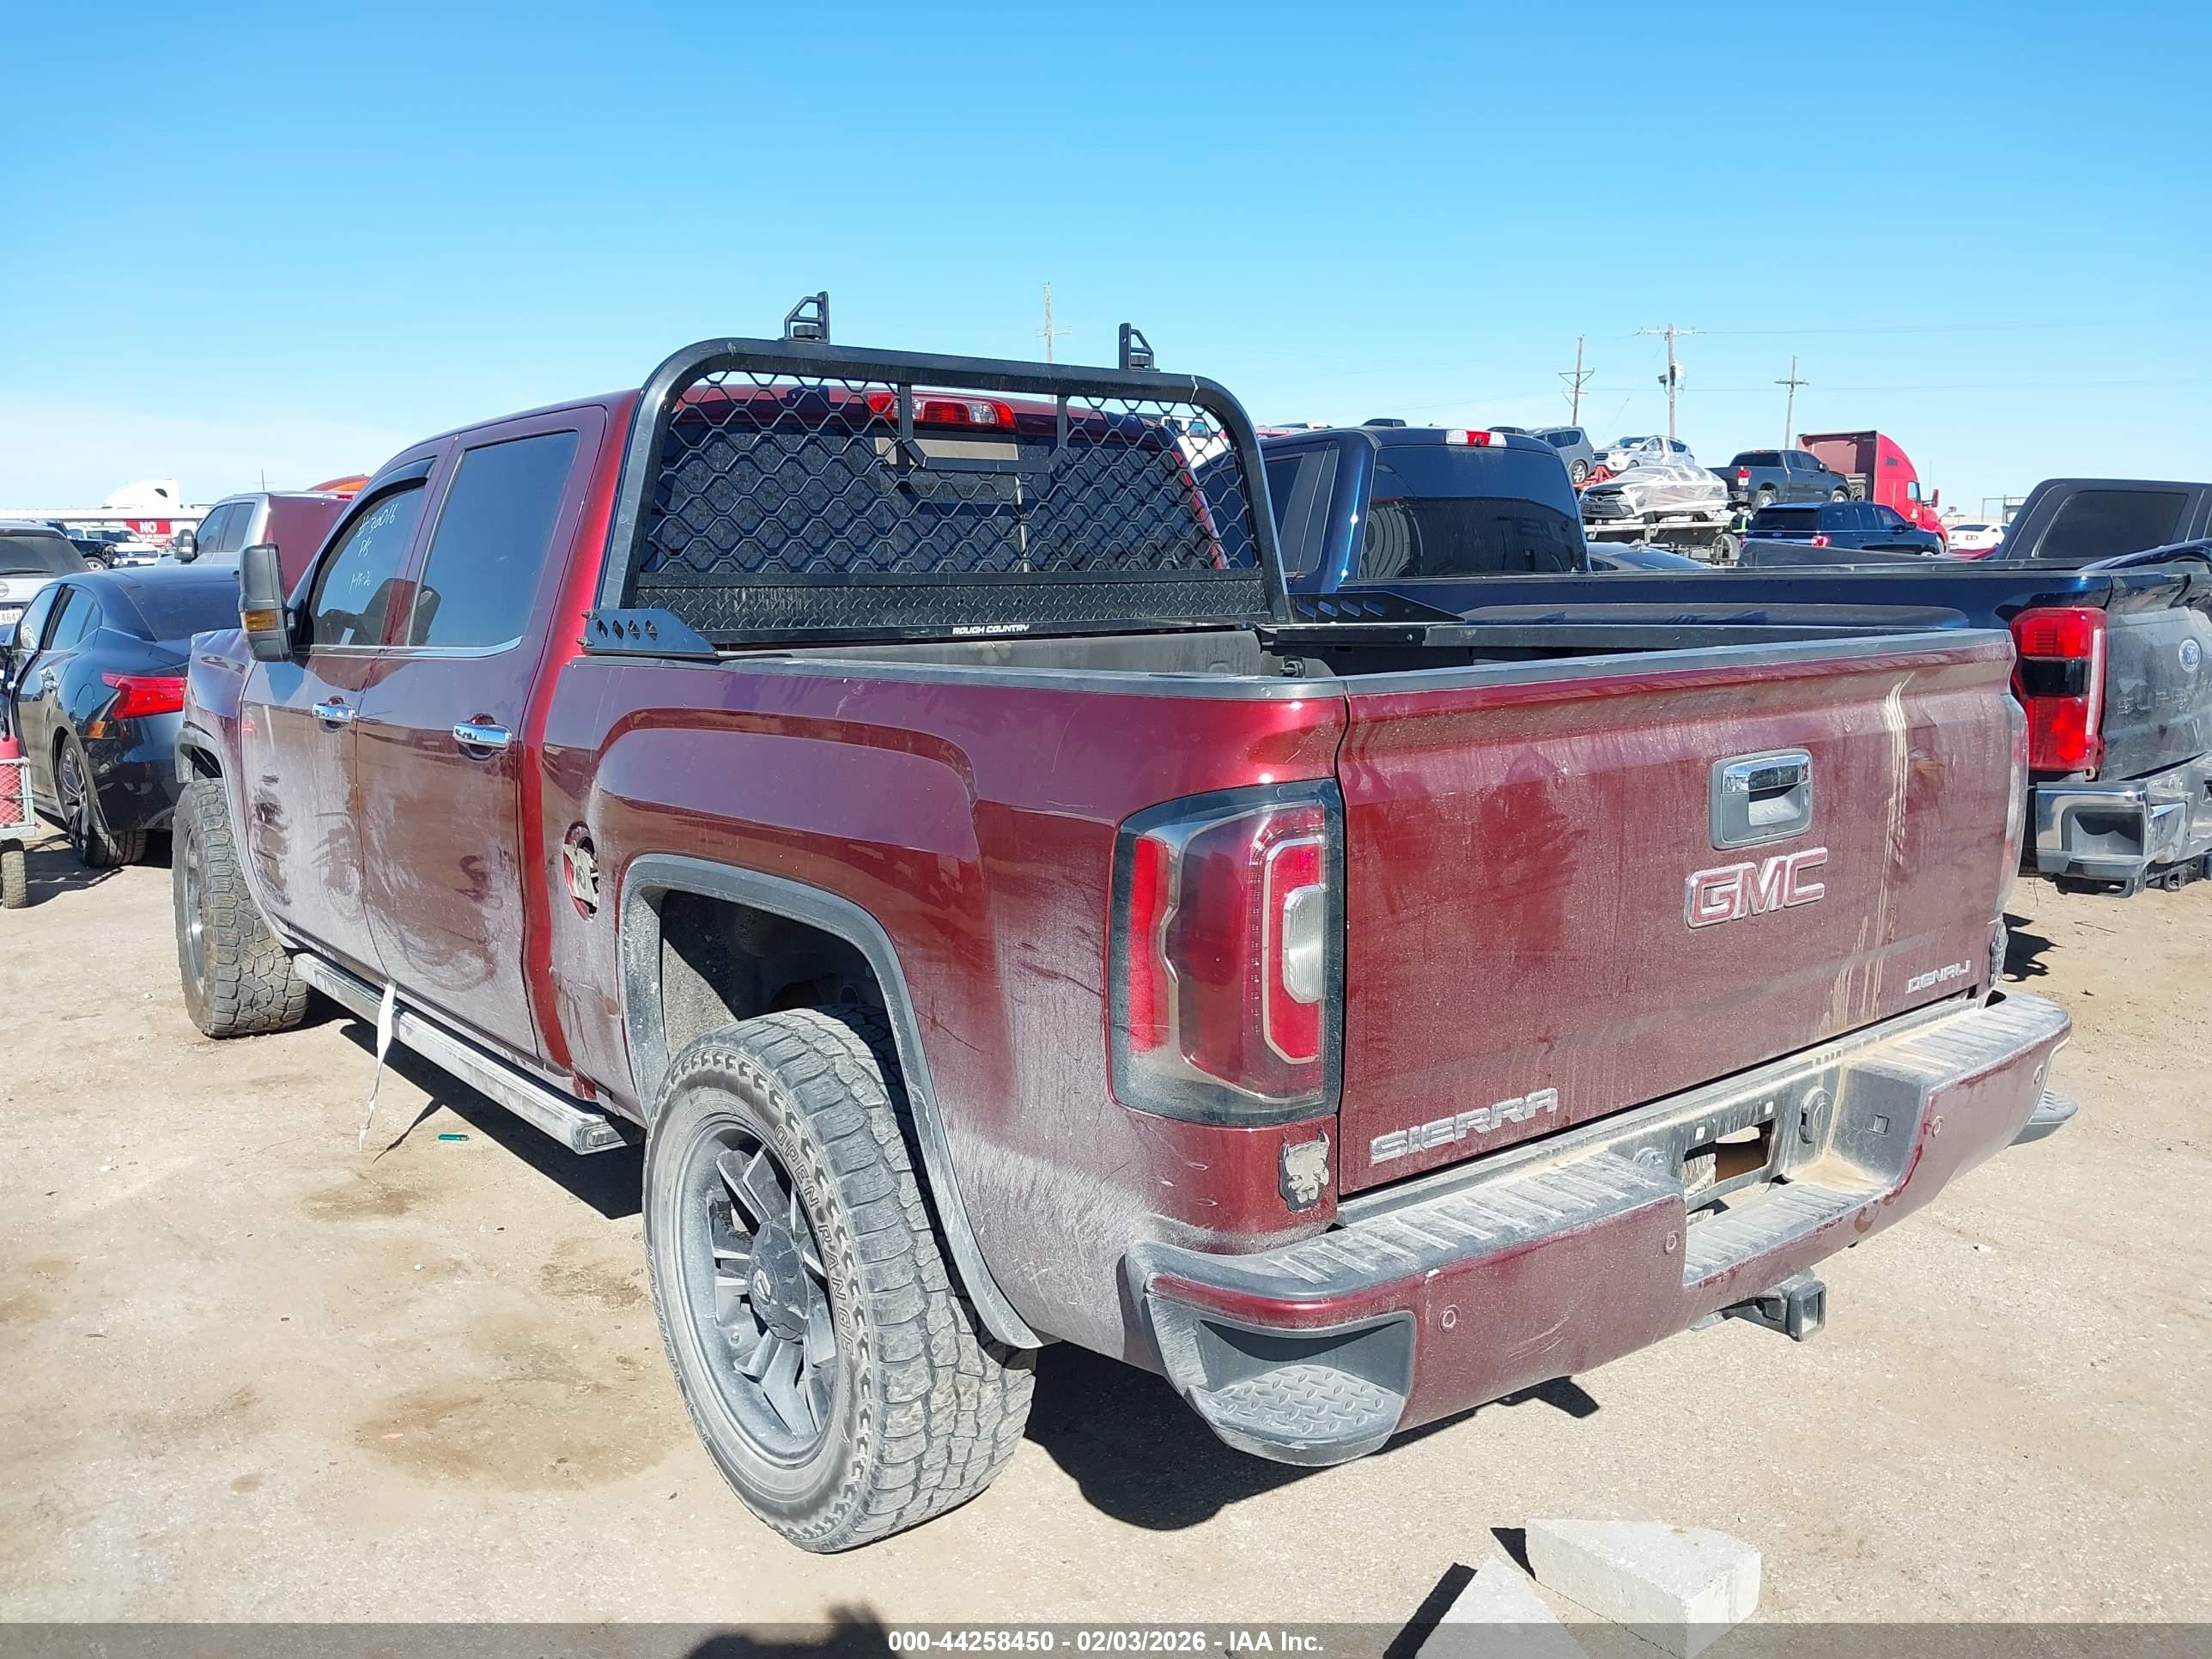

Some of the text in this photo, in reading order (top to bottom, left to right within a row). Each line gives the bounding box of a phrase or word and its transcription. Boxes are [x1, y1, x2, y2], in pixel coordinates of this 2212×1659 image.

[139, 521, 158, 534] NO
[952, 623, 1030, 635] ROUGH COUNTRY
[1684, 848, 1828, 929] GMC
[1906, 959, 1972, 994] DENALI
[1370, 1087, 1559, 1167] SIERRA
[774, 1125, 855, 1356] OPEN RANGE
